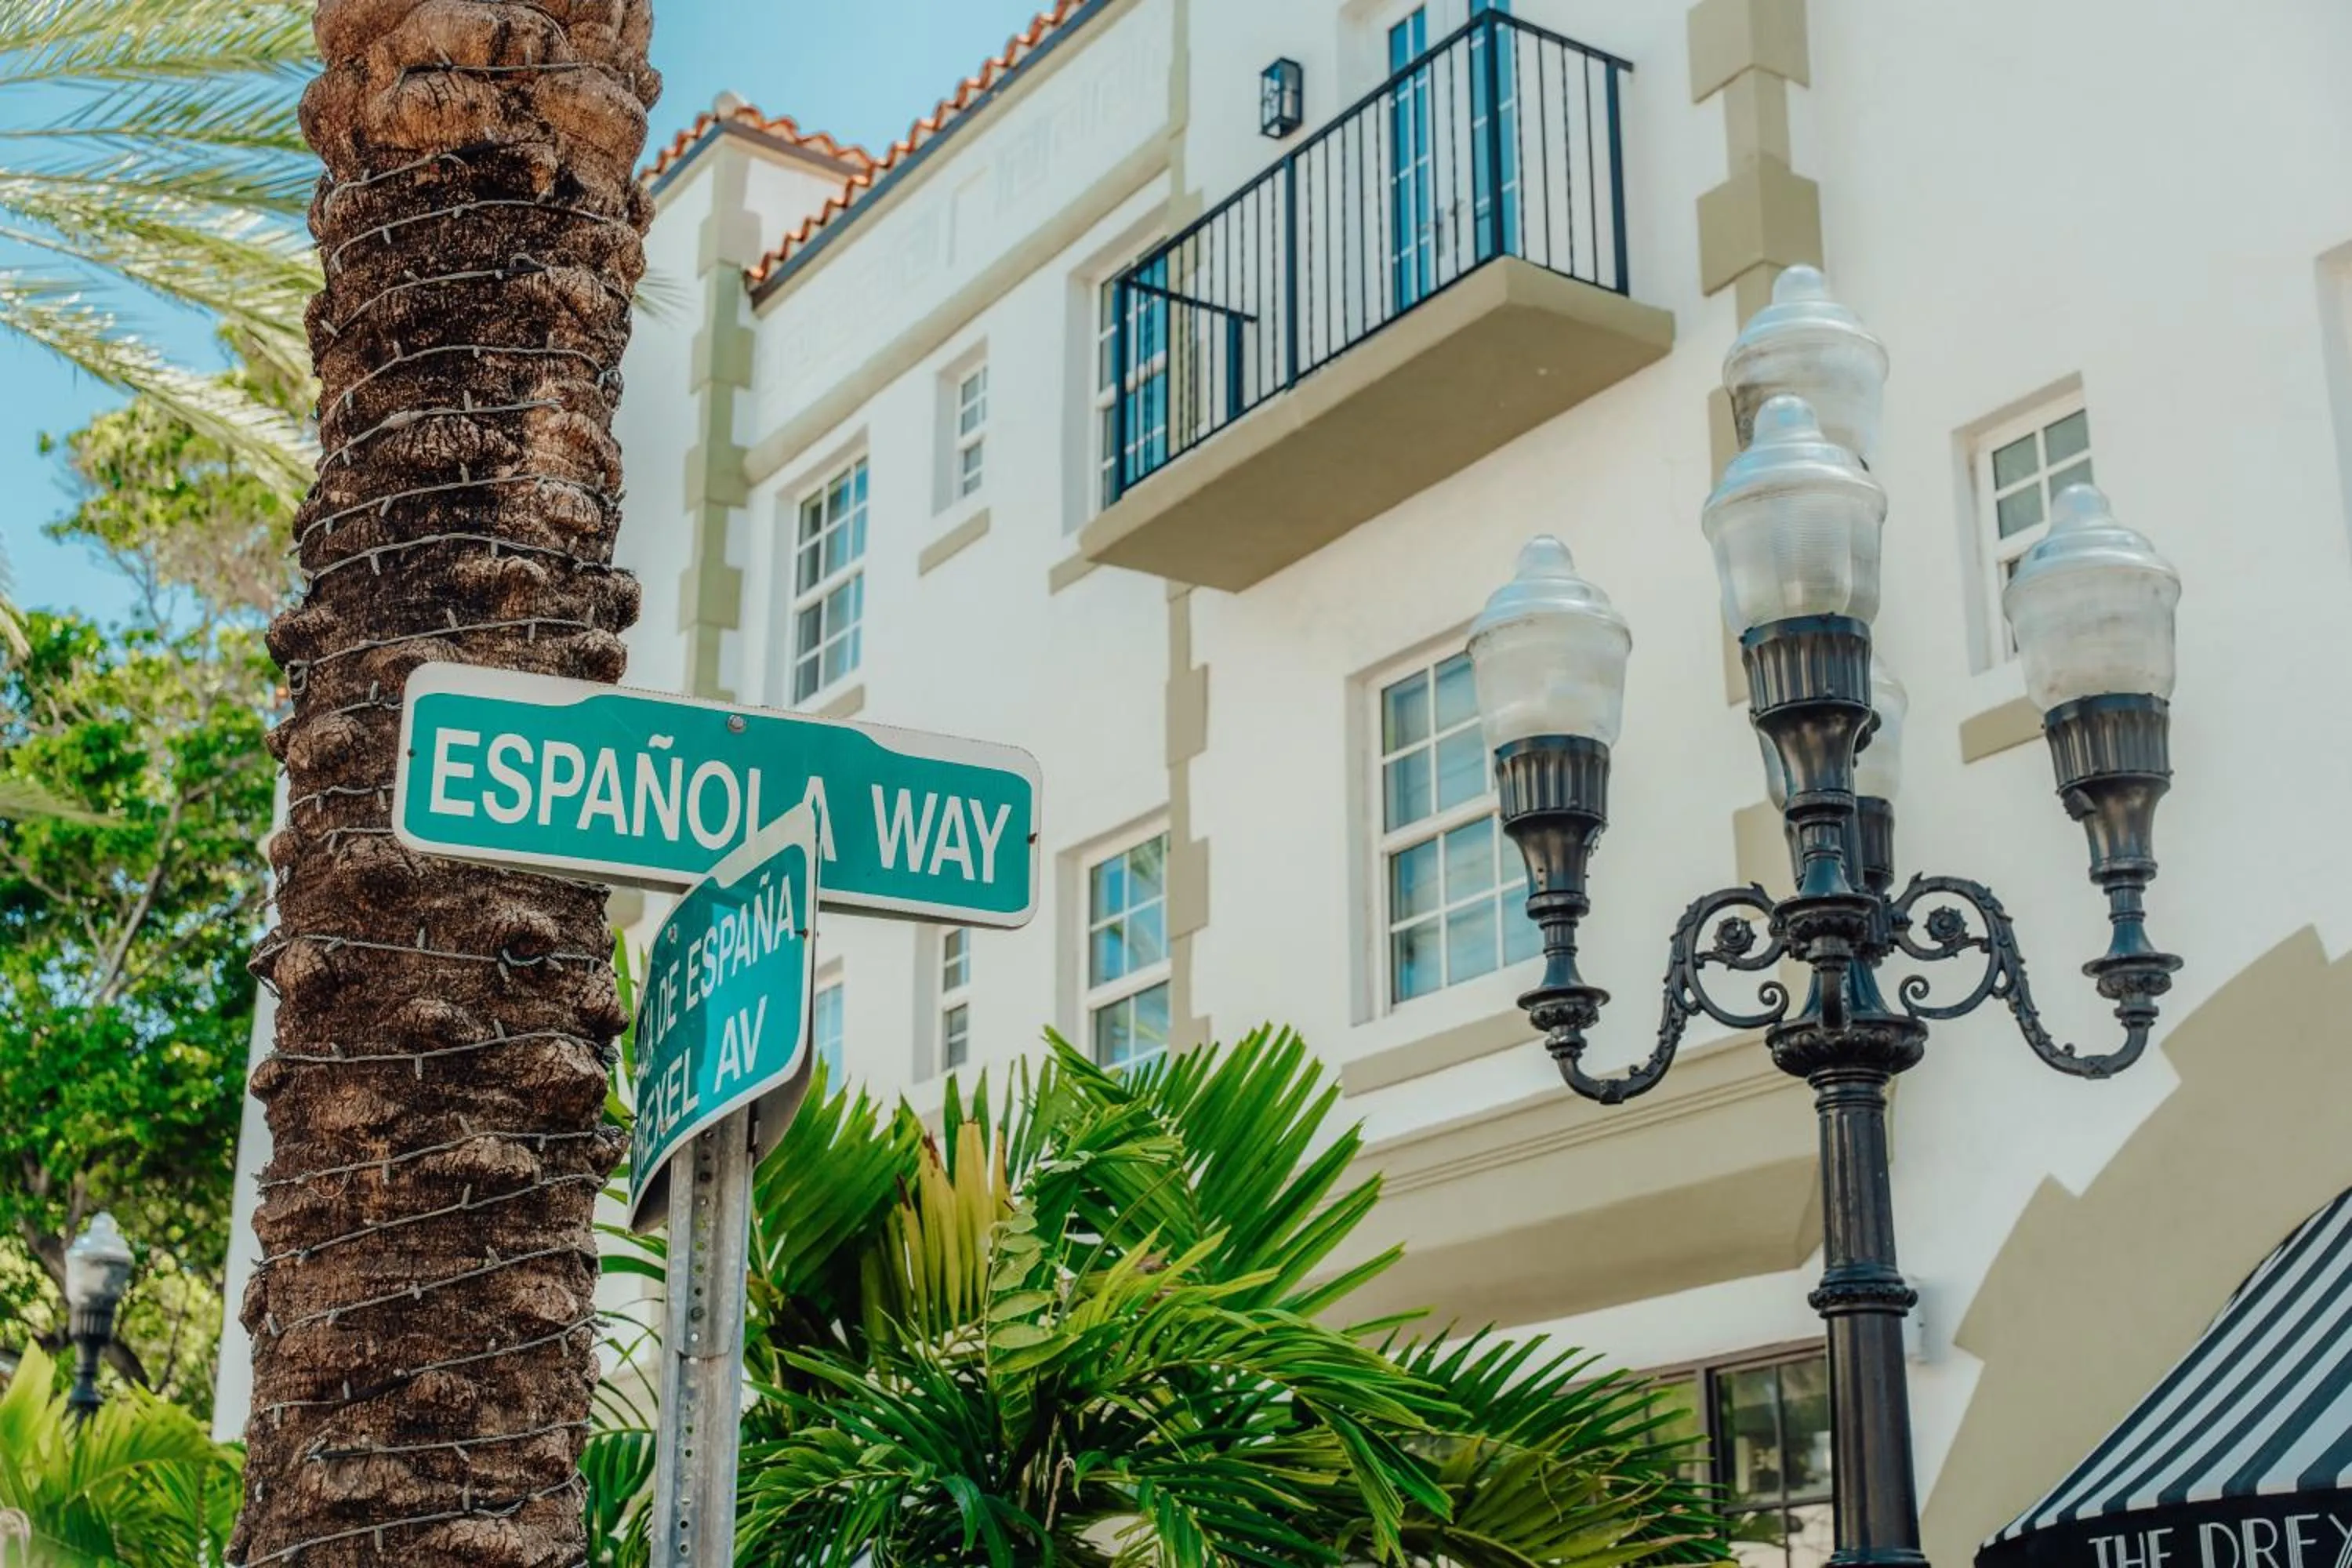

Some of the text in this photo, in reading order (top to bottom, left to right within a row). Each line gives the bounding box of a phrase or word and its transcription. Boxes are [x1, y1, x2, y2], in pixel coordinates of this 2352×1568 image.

[871, 784, 1011, 884] WAY
[657, 960, 679, 1045] DE
[685, 870, 797, 1012] ESPAÑA
[714, 995, 768, 1094] AV
[2088, 1526, 2175, 1568] THE
